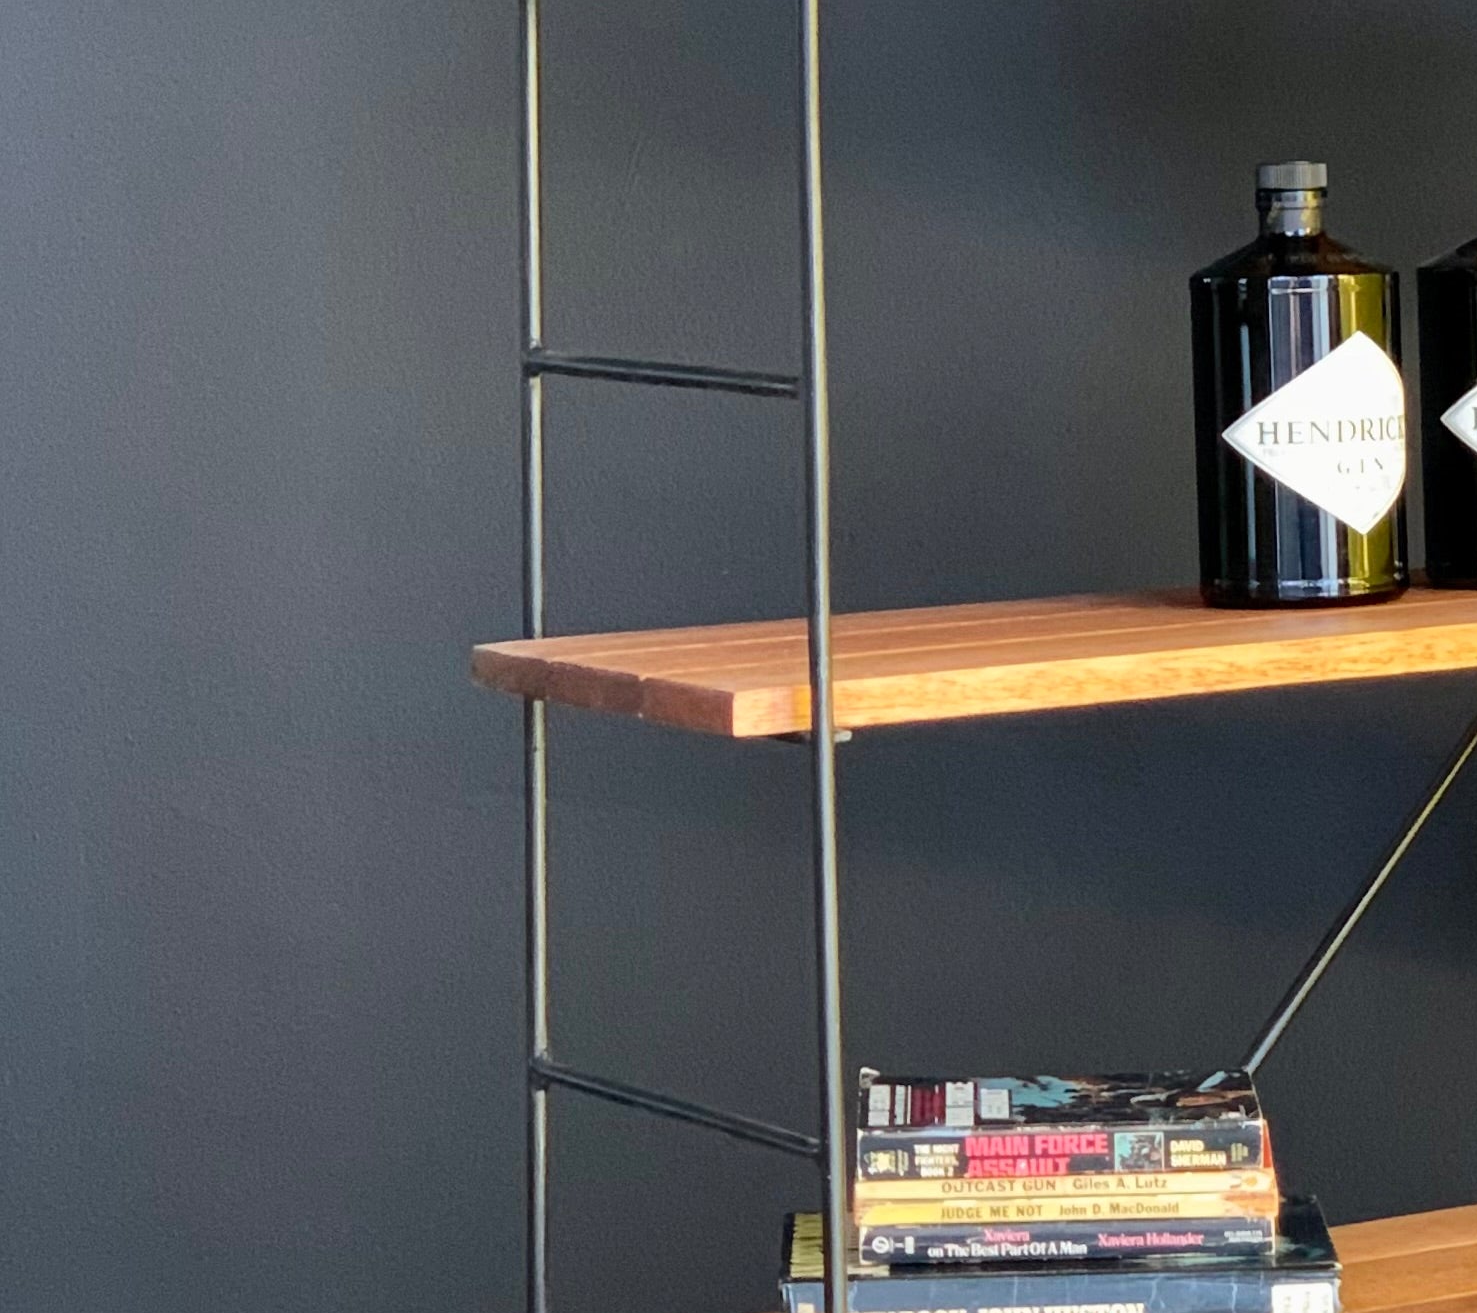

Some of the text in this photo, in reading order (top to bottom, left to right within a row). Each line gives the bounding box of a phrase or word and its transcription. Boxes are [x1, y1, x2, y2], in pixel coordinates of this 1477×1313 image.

[965, 1133, 1109, 1157] MAIN FORCE
[1170, 1139, 1204, 1153] DAVID
[1171, 1151, 1227, 1167] SHERMAN
[964, 1157, 1071, 1178] ASSAULT
[942, 1179, 1056, 1193] OUTCAST GUN
[1073, 1176, 1168, 1190] Giles A. Lutz
[941, 1205, 1043, 1218] JUDGE ME NOT
[1059, 1202, 1180, 1216] John D. MacDonald
[1097, 1232, 1205, 1247] Xaviera Hollander
[927, 1241, 1088, 1257] on The Best Part Of A Man
